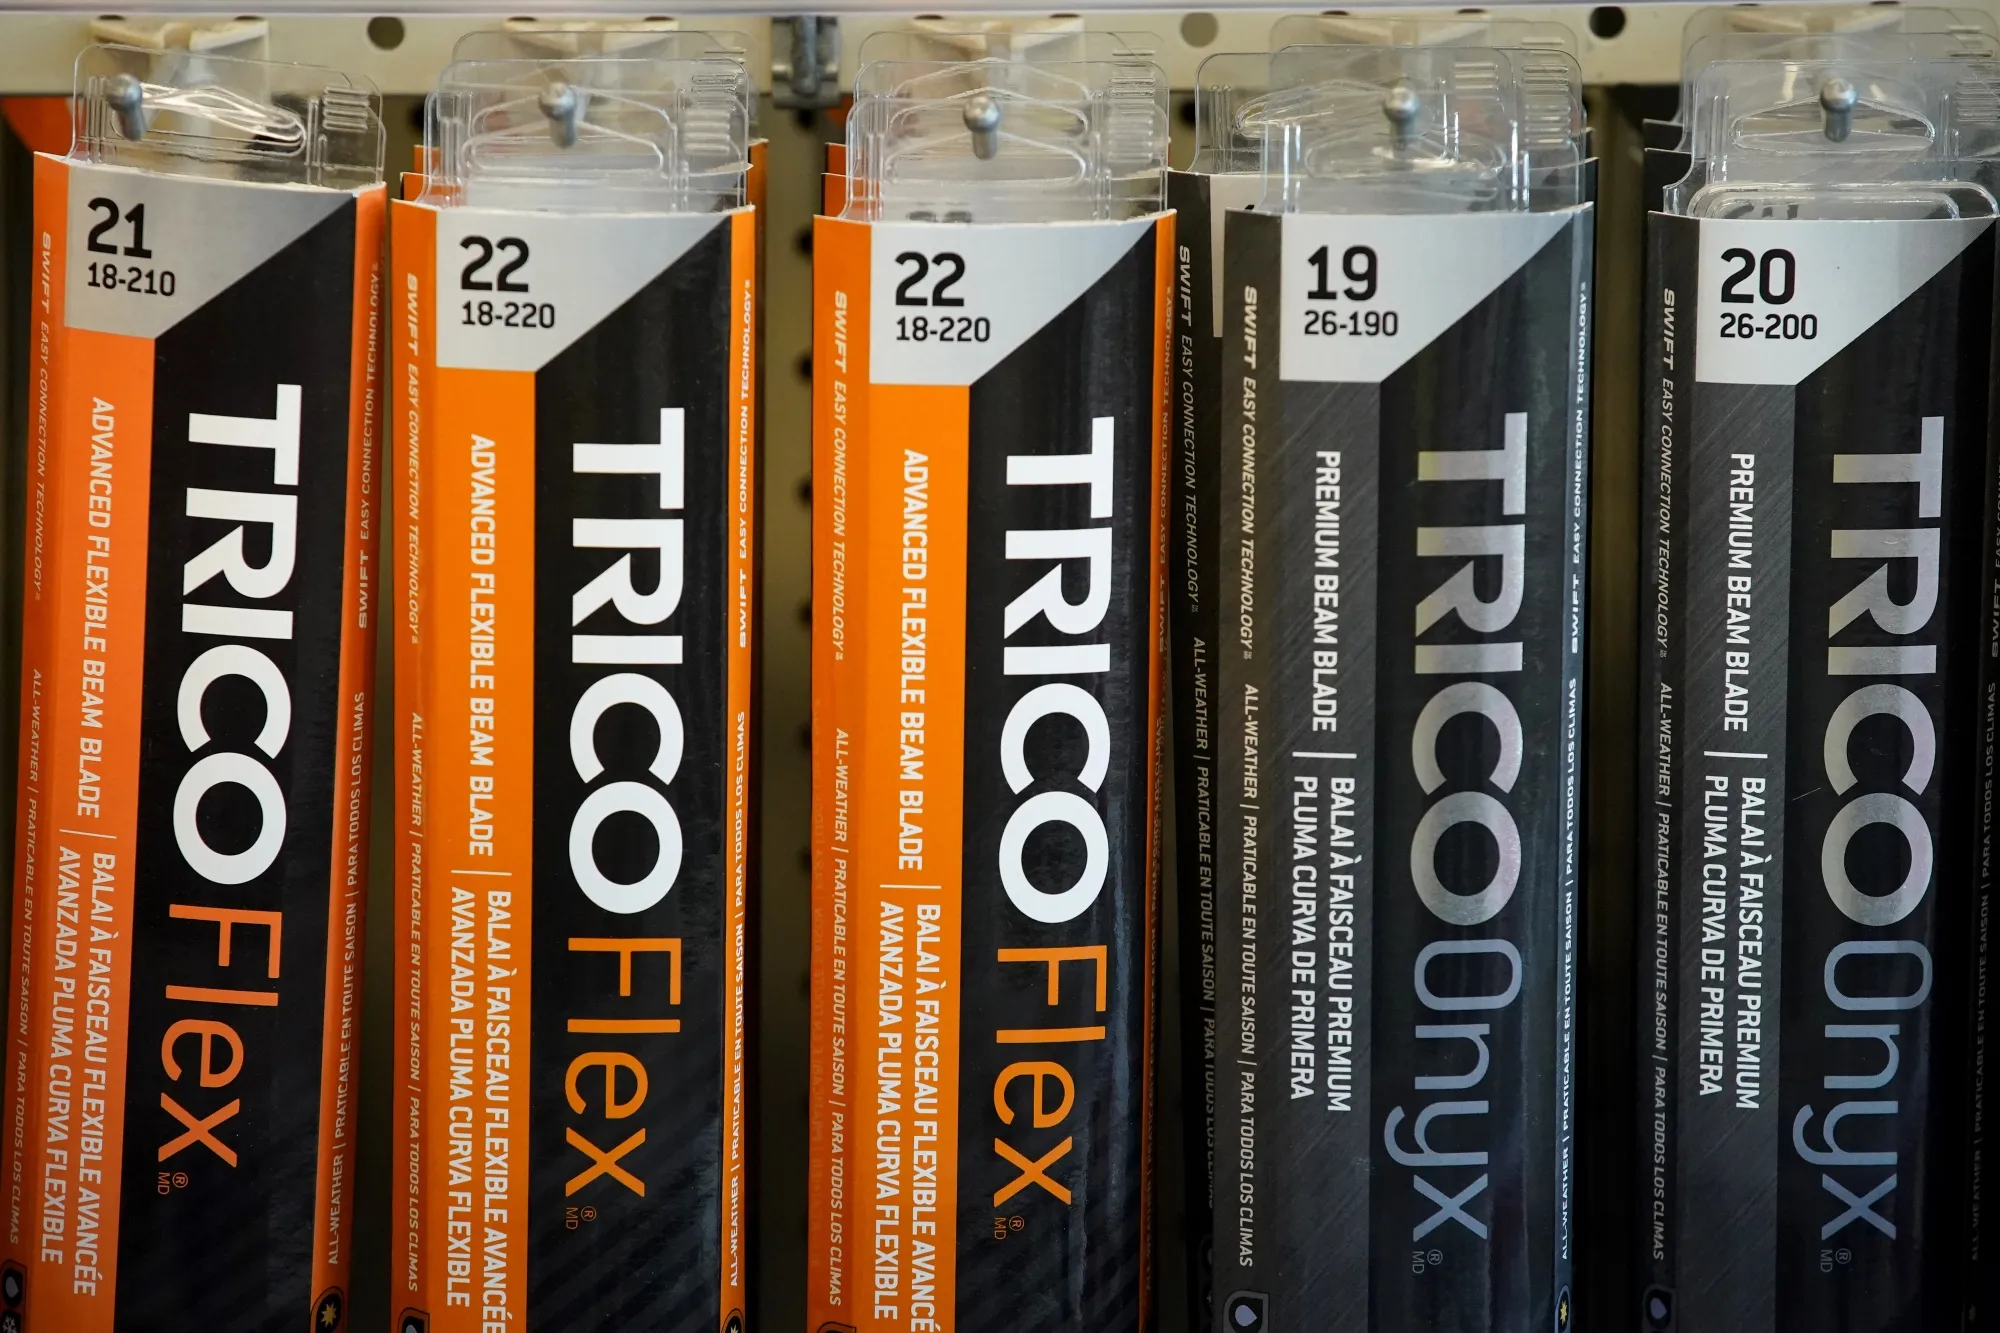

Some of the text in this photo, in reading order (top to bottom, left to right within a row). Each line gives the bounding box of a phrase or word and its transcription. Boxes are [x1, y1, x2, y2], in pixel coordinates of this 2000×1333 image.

[42, 232, 51, 313] SWIFT
[88, 198, 152, 259] 21
[88, 262, 175, 296] 18-210
[460, 236, 529, 292] 22
[896, 252, 965, 306] 22
[1308, 246, 1377, 301] 19
[1721, 248, 1795, 304] 20
[40, 321, 49, 364] EASY
[408, 274, 418, 356] SWIFT
[463, 301, 554, 328] 18-220
[835, 291, 847, 373] SWIFT
[897, 317, 990, 342] 18-220
[1244, 286, 1257, 369] SWIFT
[1305, 310, 1398, 336] 26-190
[1664, 288, 1674, 370] SWIFT
[1721, 313, 1817, 339] 26-200
[38, 369, 47, 476] CONNECTION
[408, 364, 418, 407] EASY
[835, 381, 846, 424] EASY
[1243, 377, 1256, 421] EASY
[1663, 378, 1673, 422] EASY
[409, 410, 419, 519] CONNECTION
[834, 428, 846, 536] CONNECTION
[1242, 424, 1255, 533] CONNECTION
[1660, 425, 1672, 533] CONNECTION
[78, 397, 114, 818] ADVANCED FLEXIBLE BEAM BLADE
[470, 434, 495, 856] ADVANCED FLEXIBLE BEAM BLADE
[1313, 451, 1340, 732] PREMIUM BEAM BLADE
[1725, 454, 1754, 731] PREMIUM BEAM BLADE
[899, 450, 928, 870] ADVANCED FLEXIBLE BEAM BLADE
[11, 669, 41, 1244] ALL-WEATHER PRATICABLE EN TOUTE SAISON PARA TODOS LOS CLIMAS
[488, 891, 511, 959] BALAI
[488, 964, 517, 980] À
[917, 905, 940, 972] BALAI
[1240, 684, 1258, 1266] ALL-WEATHER PRATICABLE EN TOUTE SAISON PARA TODOS LOS CLIMAS
[1291, 777, 1318, 1099] PLUMA CURVA DE PRIMERA
[1328, 778, 1361, 1111] BALAI À FAISCEAU PREMIUM
[1654, 682, 1672, 1260] ALL-WEATHER PRATICABLE EN TOUTE SAISON PARA TODOS LOS CLIMAS
[1700, 776, 1728, 1095] PLUMA CURVA DE PRIMERA
[1736, 778, 1772, 1108] BALAI À FAISCEAU PREMIUM
[409, 713, 422, 1291] ALL-WEATHER PRATICABLE EN TOUTE SAISON PARA TODOS LOS CLIMAS
[830, 729, 848, 1305] ALL-WEATHER PRATICABLE EN TOUTE SAISON PARA TODOS LOS CLIMAS
[916, 978, 946, 994] À
[42, 846, 80, 1264] AVANZADA PLUMA CURVA FLEXIBLE
[74, 853, 118, 1296] BALAI À FAISCEAU FLEXIBLE AVANCÉE
[447, 887, 475, 1306] AVANZADA PLUMA CURVA FLEXIBLE
[486, 987, 510, 1101] FAISCEAU
[914, 1000, 939, 1113] FAISCEAU
[875, 902, 903, 1319] AVANZADA PLUMA CURVA FLEXIBLE
[485, 1108, 508, 1223] FLEXIBLE
[913, 1121, 937, 1235] FLEXIBLE
